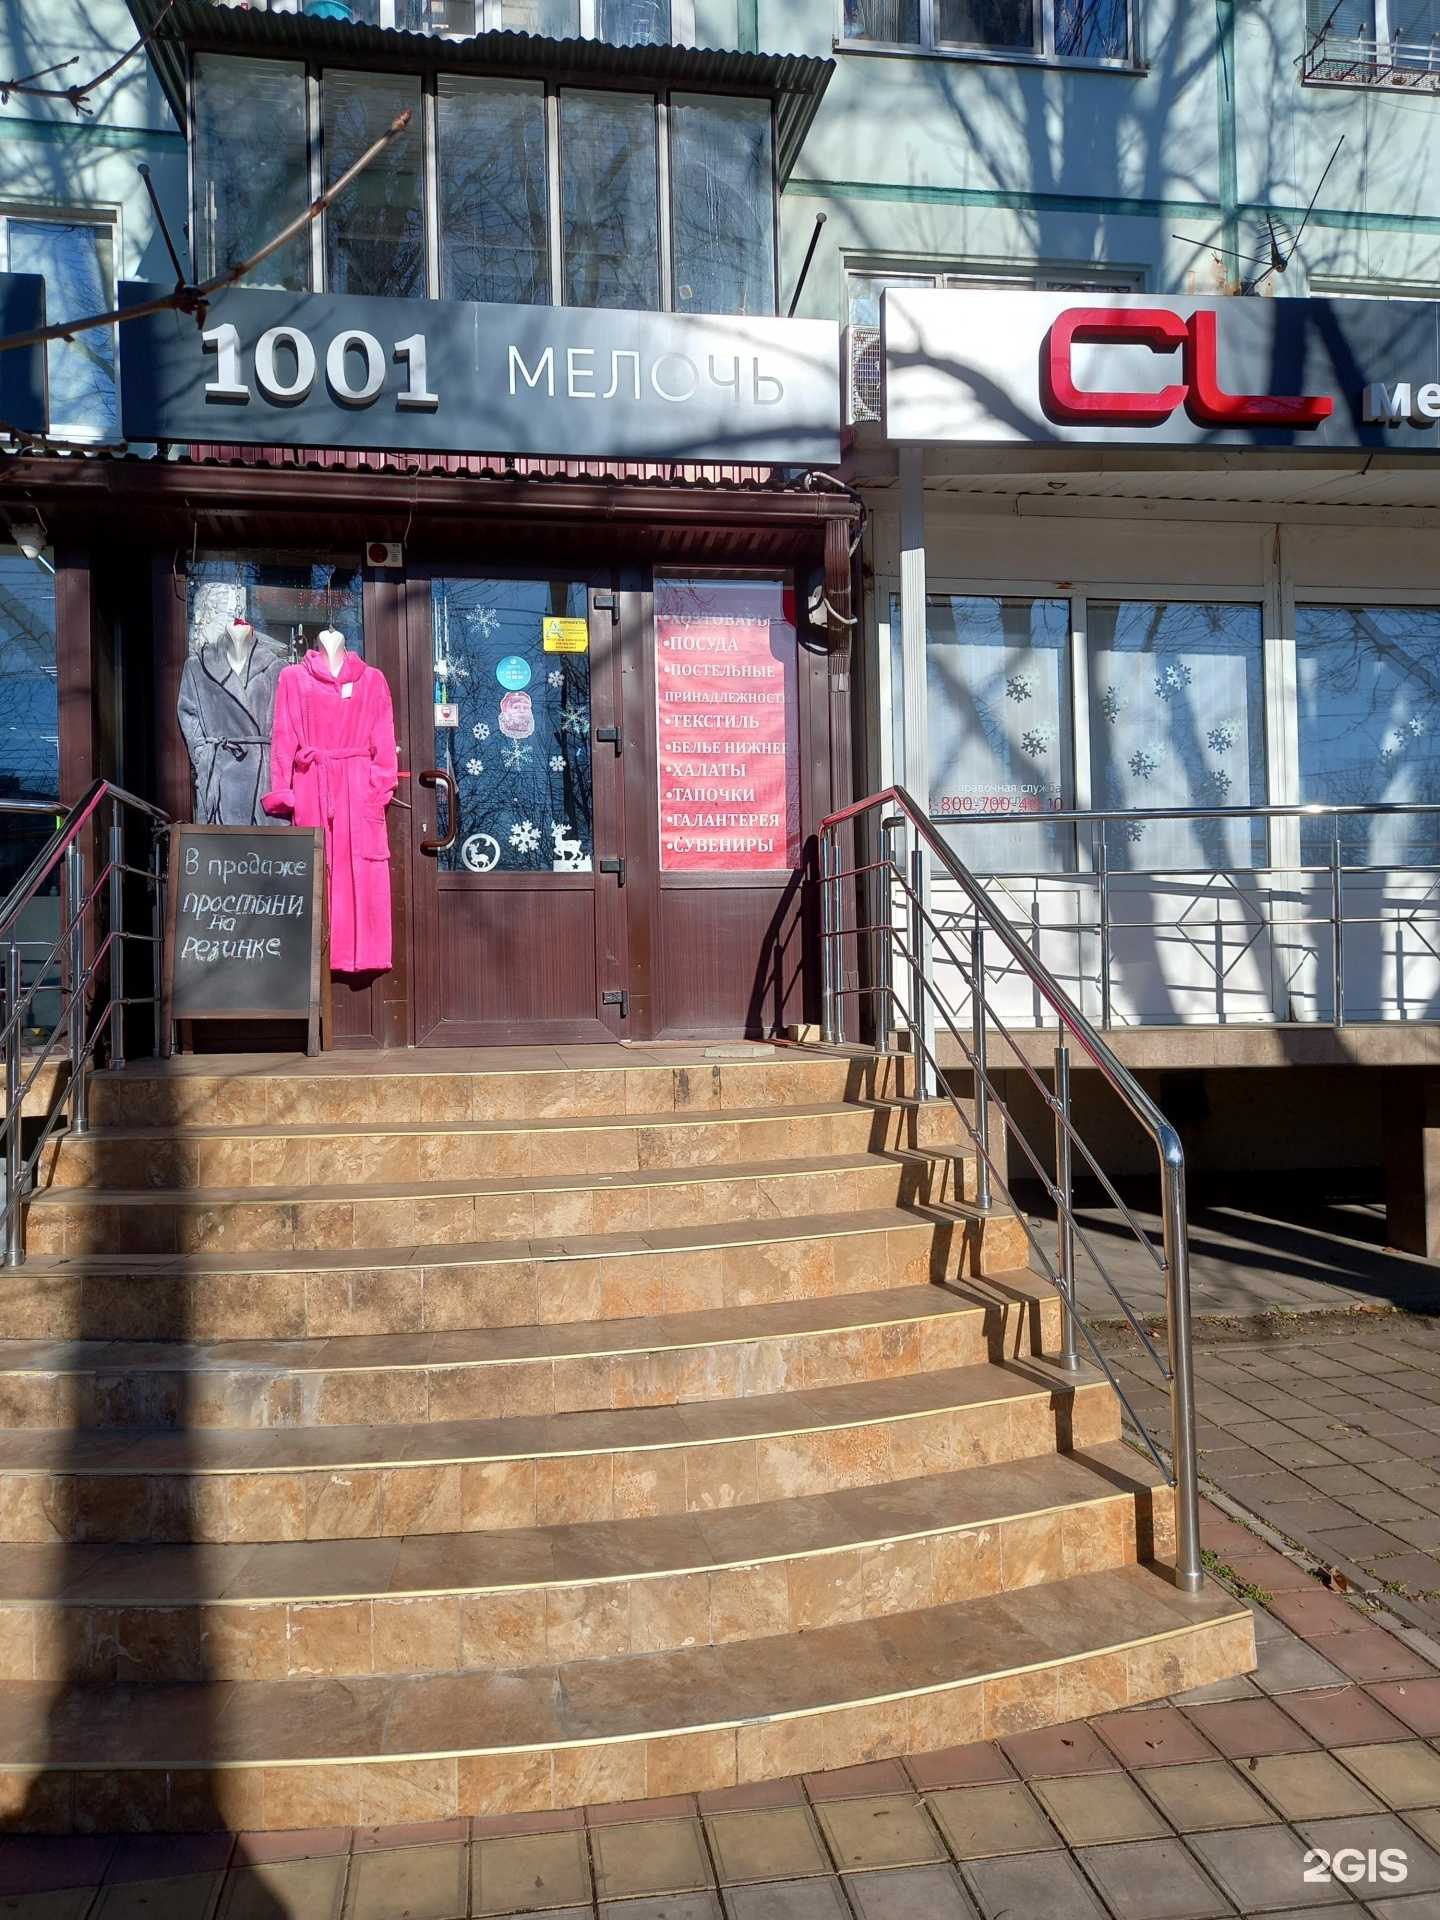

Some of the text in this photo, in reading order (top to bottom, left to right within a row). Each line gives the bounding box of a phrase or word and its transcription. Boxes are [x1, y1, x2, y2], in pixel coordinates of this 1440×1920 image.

[203, 323, 785, 408] 1001 МЕЛОЧЬ
[670, 636, 738, 653] ПОСУДА
[671, 663, 775, 678] ПОСТЕЛЬНЫЕ
[665, 691, 787, 704] ПРИНАДЛЕЖНОСТ
[671, 714, 760, 729] ТЕКСТИЛЬ
[672, 741, 721, 754] БЕЛЬЕ
[672, 763, 747, 777] ХАЛАТЫ
[672, 788, 755, 802] ТАПОЧКИ
[672, 813, 780, 827] ГАЛАНТЕРЕЯ
[673, 838, 774, 853] СУВЕНИРЫ
[185, 847, 307, 884] В продаже
[208, 914, 237, 931] на
